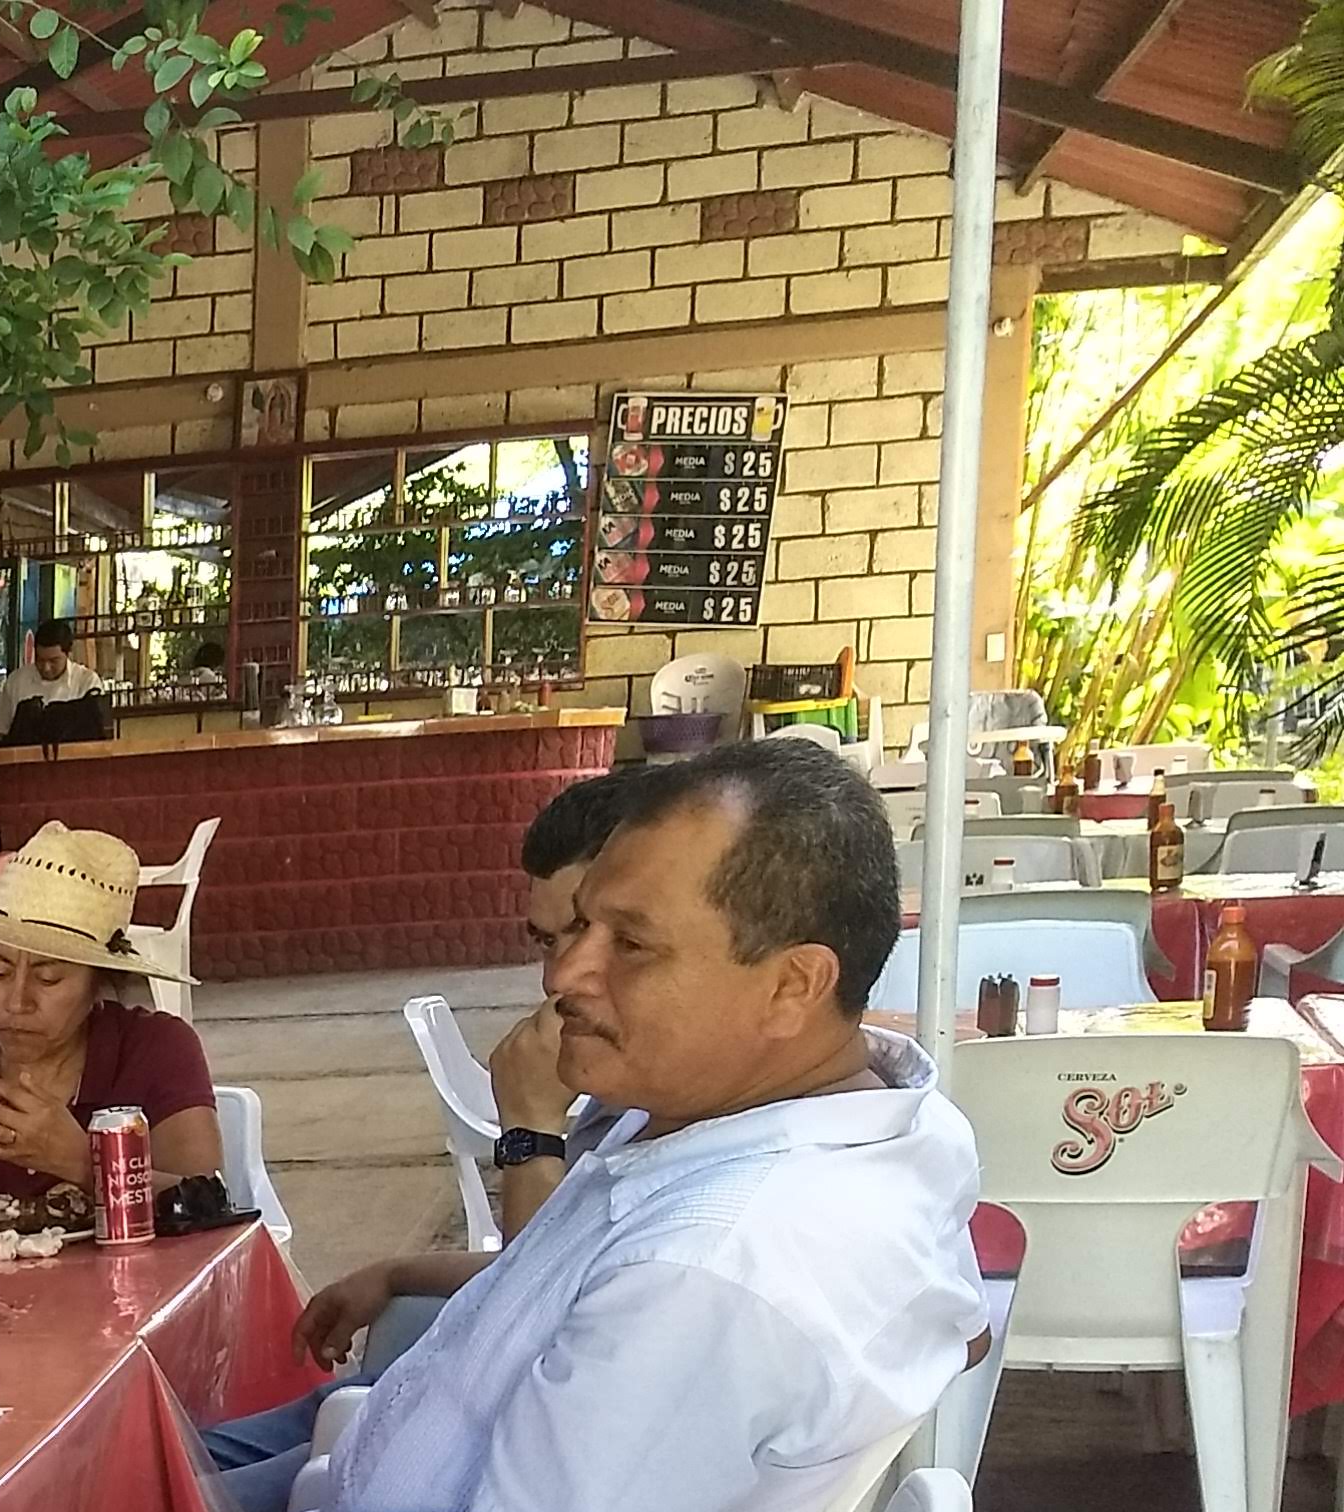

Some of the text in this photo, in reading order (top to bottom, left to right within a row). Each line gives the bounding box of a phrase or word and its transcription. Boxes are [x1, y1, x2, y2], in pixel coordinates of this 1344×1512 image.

[650, 405, 748, 435] PRECIOS
[675, 456, 706, 466] MEDIA
[670, 492, 701, 501] MEDIA
[665, 529, 695, 539] MEDIA
[659, 564, 689, 574] MEDIA
[655, 601, 685, 611] MEDIA
[1057, 1073, 1117, 1082] CERVEZA
